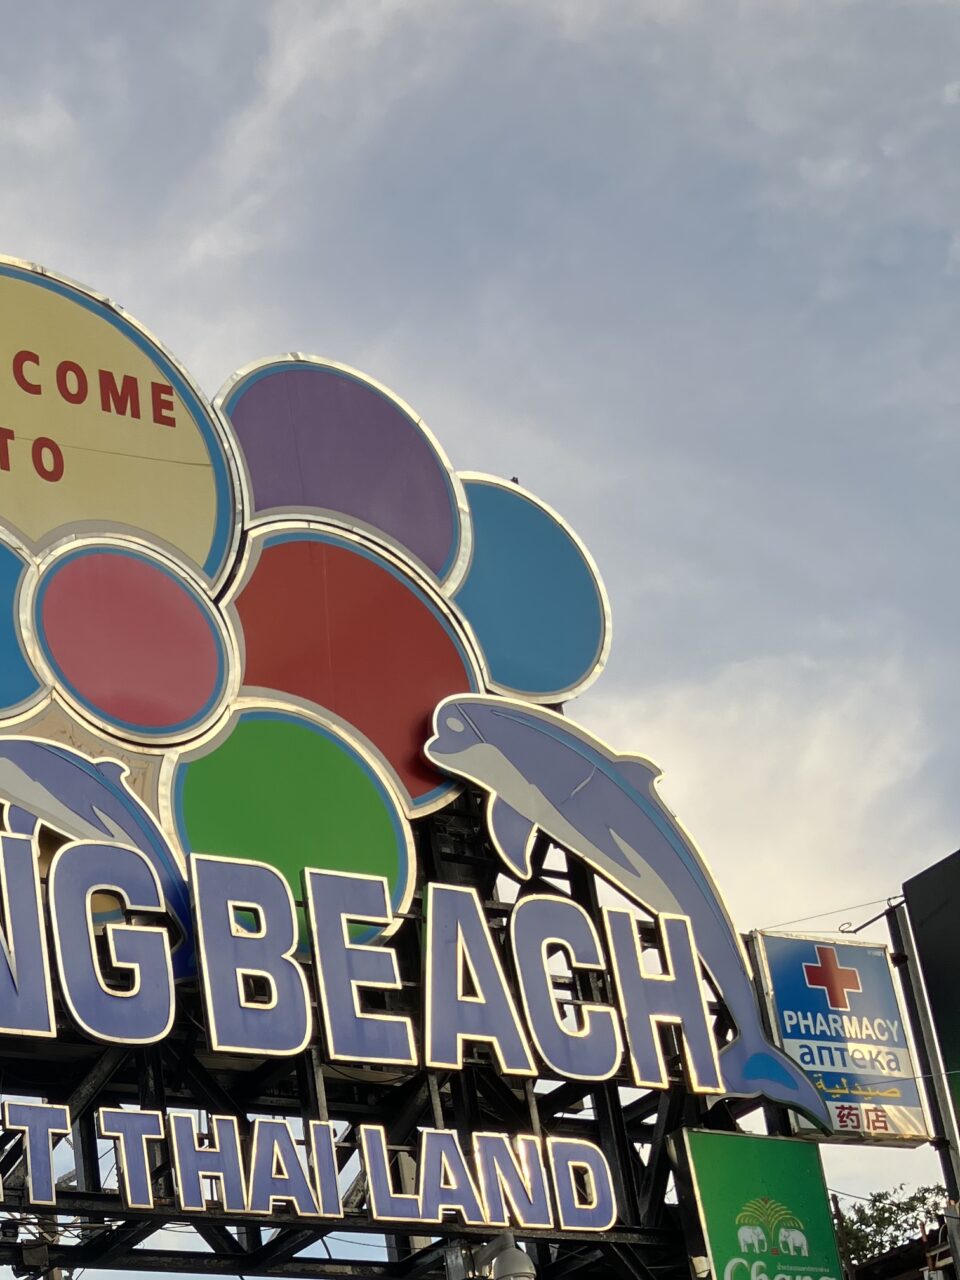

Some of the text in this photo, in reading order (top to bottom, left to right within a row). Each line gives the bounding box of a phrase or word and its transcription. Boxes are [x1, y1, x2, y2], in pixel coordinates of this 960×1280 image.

[189, 852, 726, 1096] BEACH
[783, 1009, 899, 1043] PHARMACY
[799, 1043, 901, 1073] аптека
[834, 1103, 889, 1132] 药店
[96, 1107, 618, 1233] THAILAND
